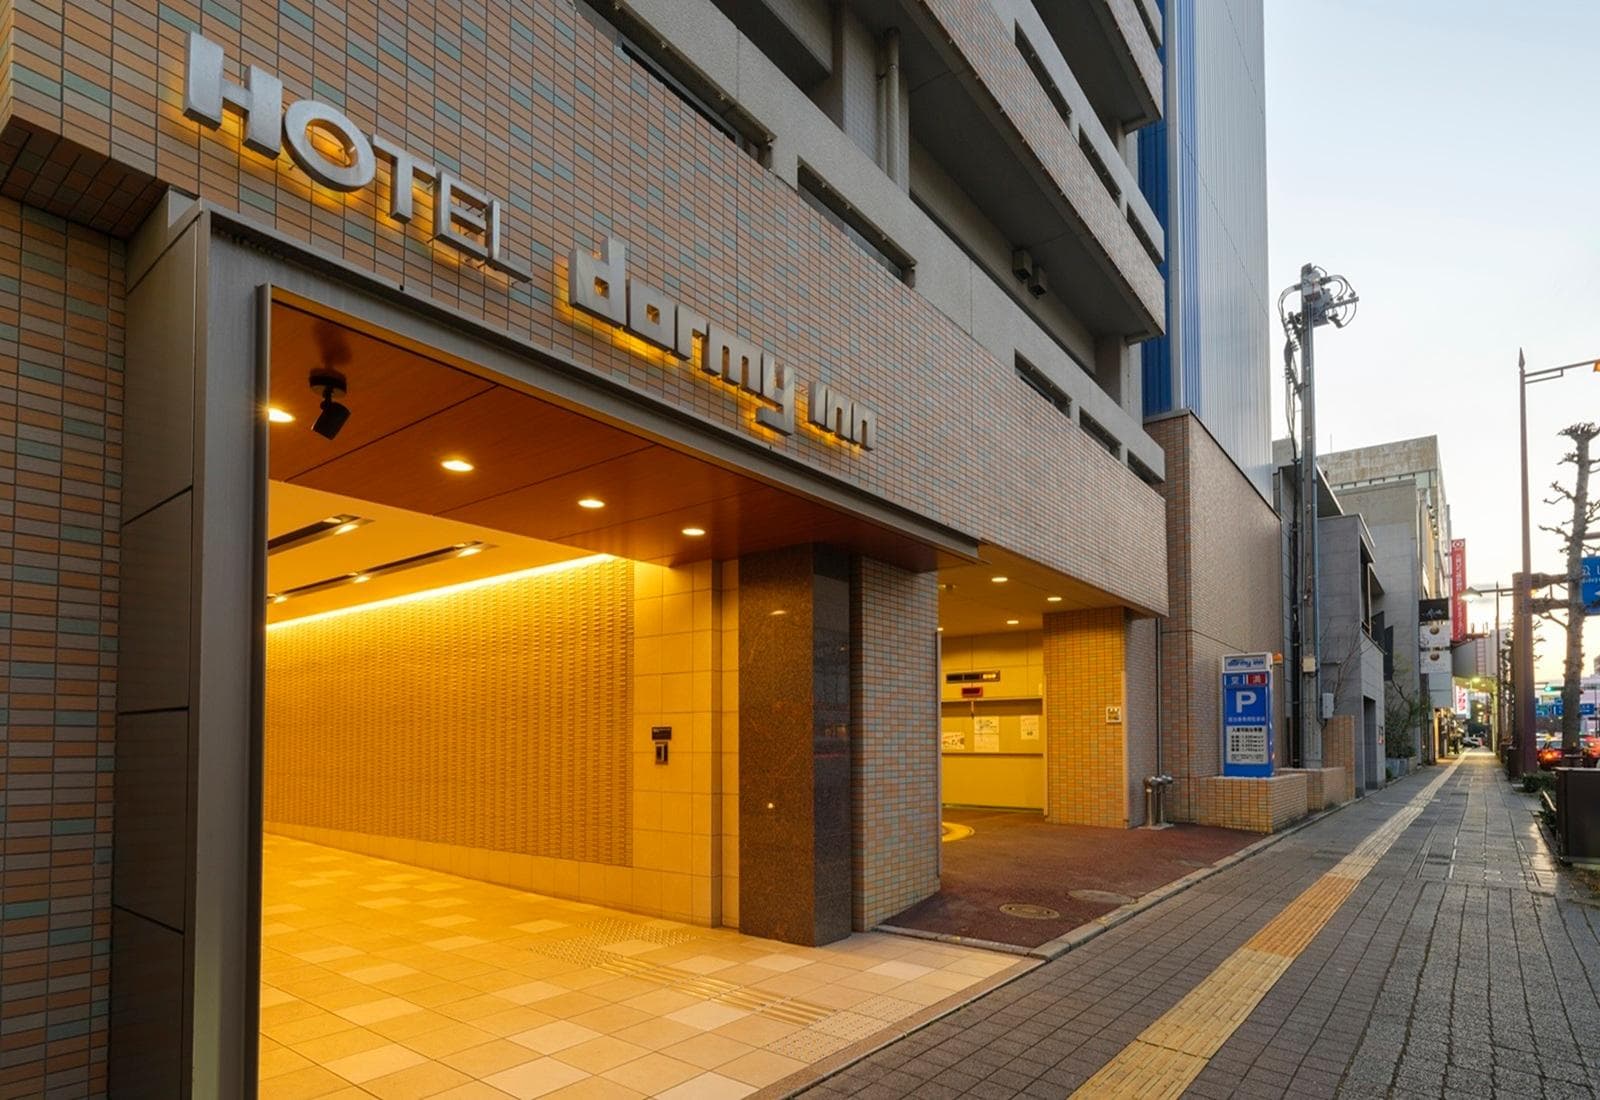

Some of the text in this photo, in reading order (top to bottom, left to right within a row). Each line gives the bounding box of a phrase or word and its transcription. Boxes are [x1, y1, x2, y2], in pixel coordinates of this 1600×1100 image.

[182, 31, 533, 283] HOTEL
[568, 237, 795, 436] dormy
[1236, 691, 1257, 713] P
